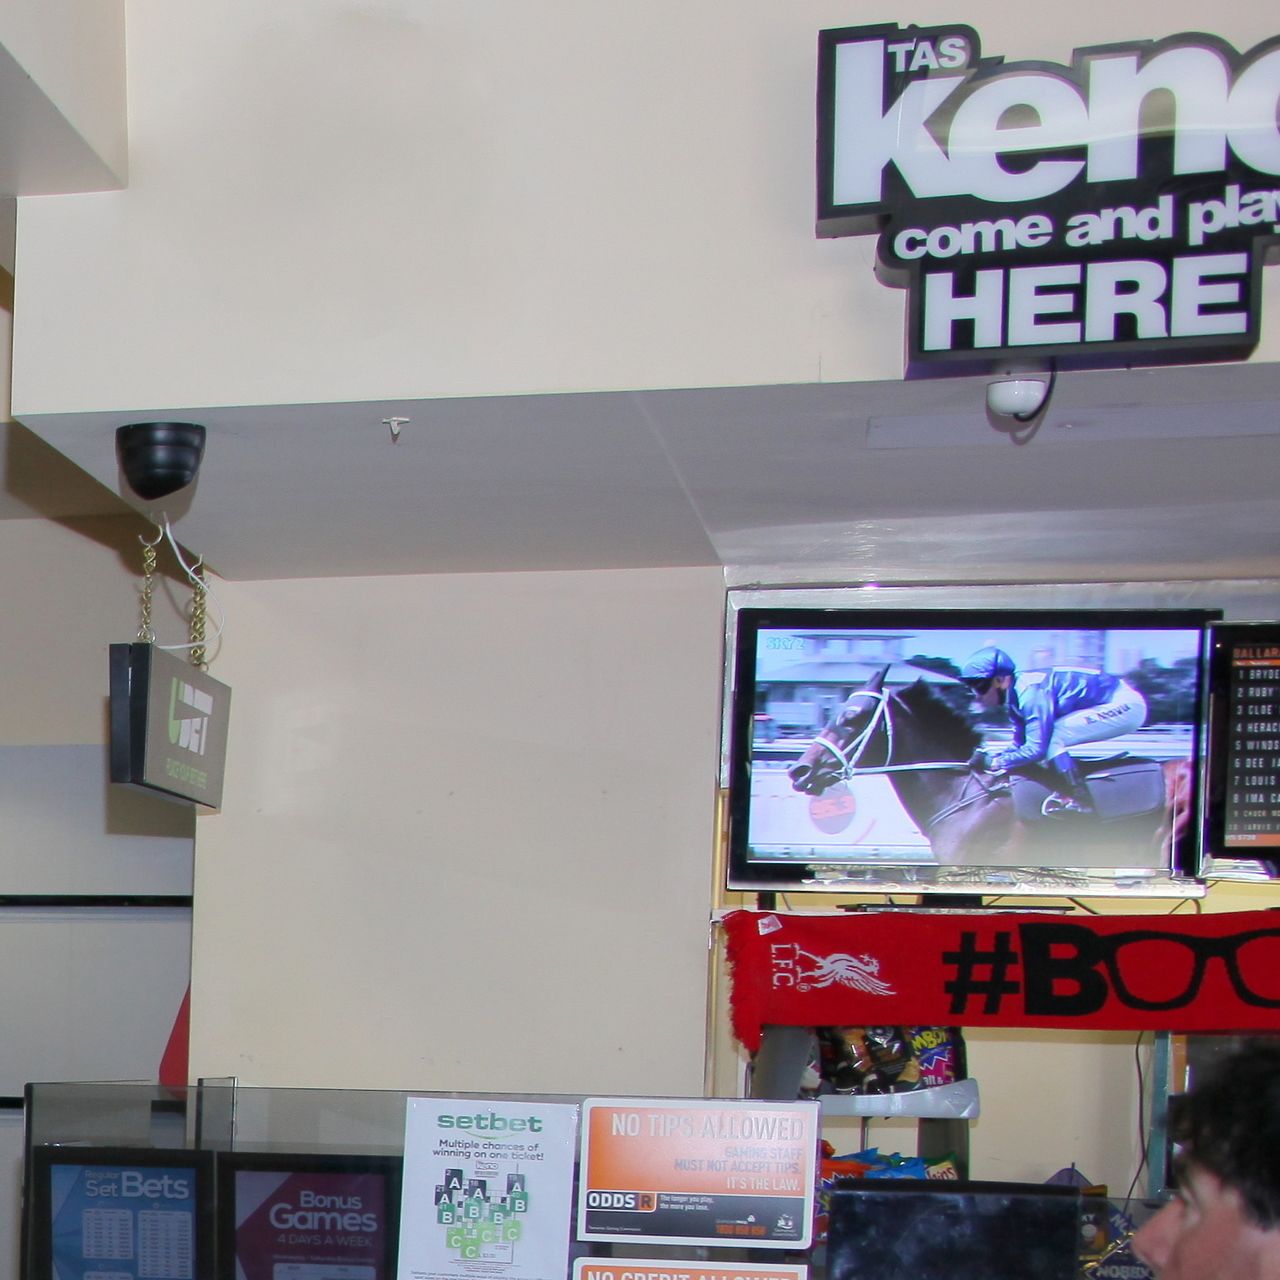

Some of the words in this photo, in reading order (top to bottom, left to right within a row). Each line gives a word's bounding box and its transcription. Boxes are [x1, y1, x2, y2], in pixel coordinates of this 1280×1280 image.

[887, 37, 967, 73] TAS
[894, 213, 1053, 260] come
[1065, 196, 1174, 248] and
[924, 253, 1247, 350] HERE
[1245, 775, 1276, 787] LOUIS
[770, 942, 794, 991] L.F.C.
[437, 1113, 543, 1132] setbet
[612, 1113, 640, 1137] NO
[648, 1114, 693, 1138] TIPS
[703, 1115, 804, 1141] ALLOWED
[439, 1139, 480, 1151] Multiple
[482, 1141, 525, 1151] chances
[528, 1142, 539, 1151] of
[432, 1149, 471, 1160] winning
[474, 1152, 487, 1160] on
[489, 1151, 509, 1160] one
[511, 1151, 544, 1161] ticket!
[725, 1148, 768, 1160] GAMING
[771, 1148, 803, 1160] STAFF
[675, 1159, 704, 1171] MUST
[707, 1160, 727, 1172] NOT
[730, 1160, 770, 1173] ACCEPT
[776, 1161, 801, 1173] TIPS.
[85, 1170, 120, 1179] Regular
[86, 1180, 118, 1197] Set
[121, 1171, 189, 1199] Bets
[727, 1177, 747, 1189] IT'S
[751, 1178, 769, 1190] THE
[773, 1178, 800, 1192] LAW.
[300, 1191, 362, 1209] Bonus
[589, 1193, 635, 1208] ODDS
[641, 1196, 652, 1208] R
[660, 1195, 669, 1203] The
[670, 1195, 687, 1204] longer
[689, 1197, 699, 1205] you
[269, 1203, 378, 1232] Games
[277, 1234, 286, 1244] 4
[289, 1235, 320, 1246] DAYS
[324, 1235, 334, 1245] A
[335, 1236, 373, 1247] WEEK
